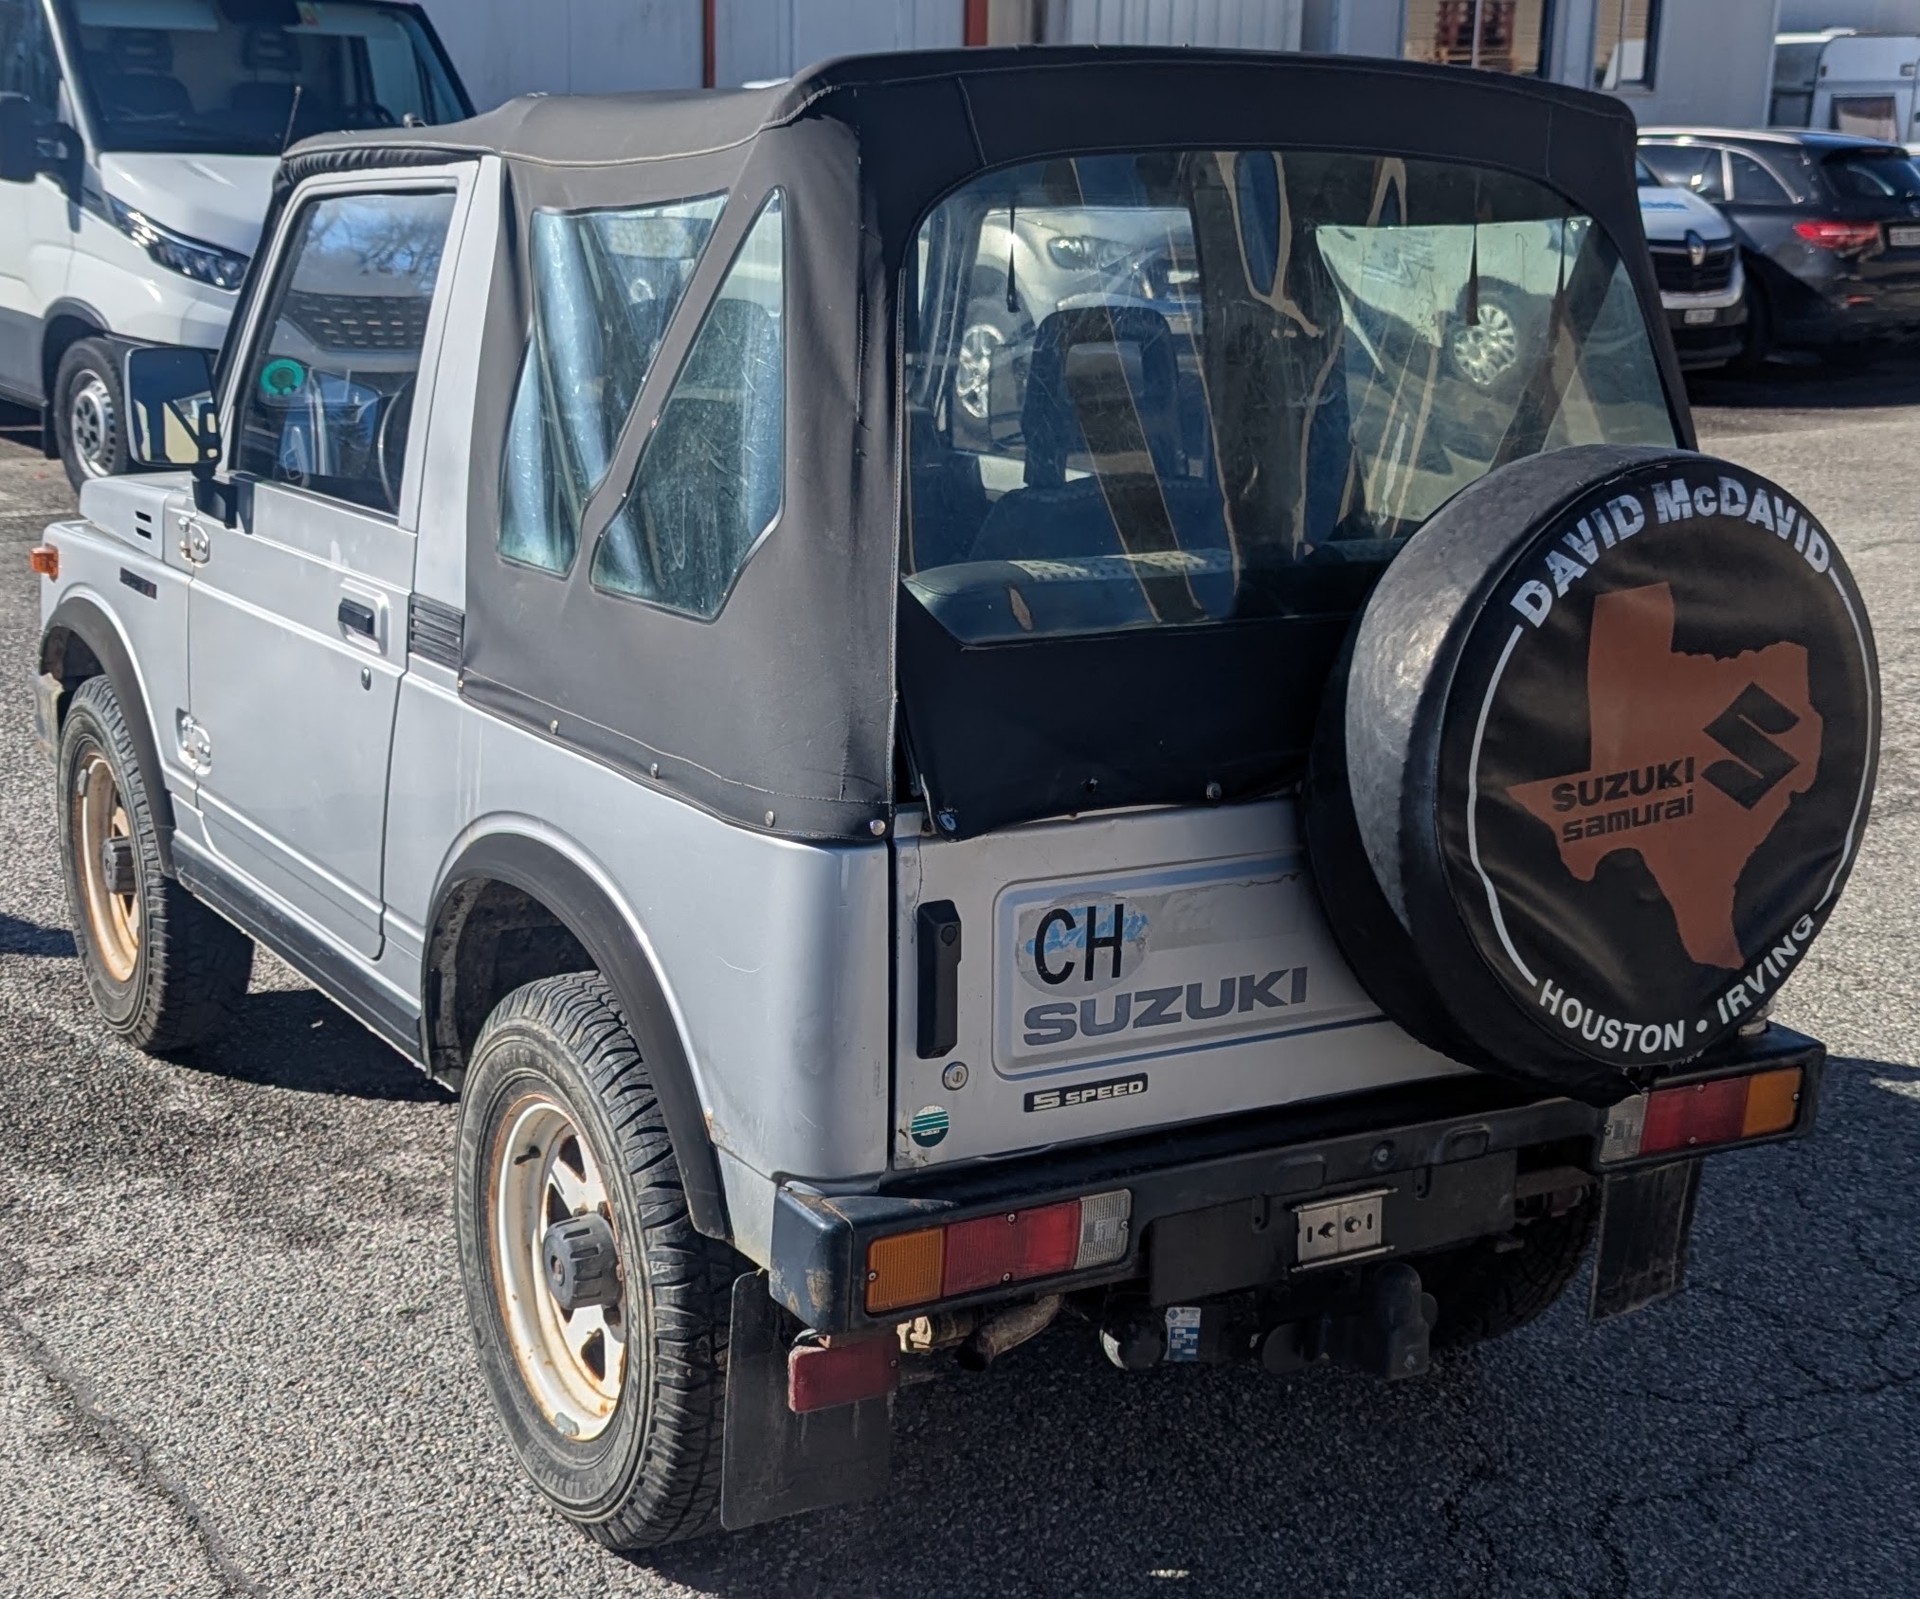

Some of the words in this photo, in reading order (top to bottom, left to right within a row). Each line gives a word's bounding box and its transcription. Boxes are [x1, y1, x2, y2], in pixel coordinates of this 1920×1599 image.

[1511, 494, 1645, 628] DAVID
[1653, 476, 1830, 574] McDAVID
[1552, 757, 1695, 812] SUZUKI
[1563, 789, 1695, 843] samurai
[1034, 903, 1124, 985] CH
[1539, 979, 1685, 1053] HOUSTON
[1717, 913, 1815, 1024] IRVING
[1024, 967, 1308, 1046] SUZUKI
[1033, 1091, 1061, 1110] 5
[1066, 1080, 1144, 1105] SPEED
